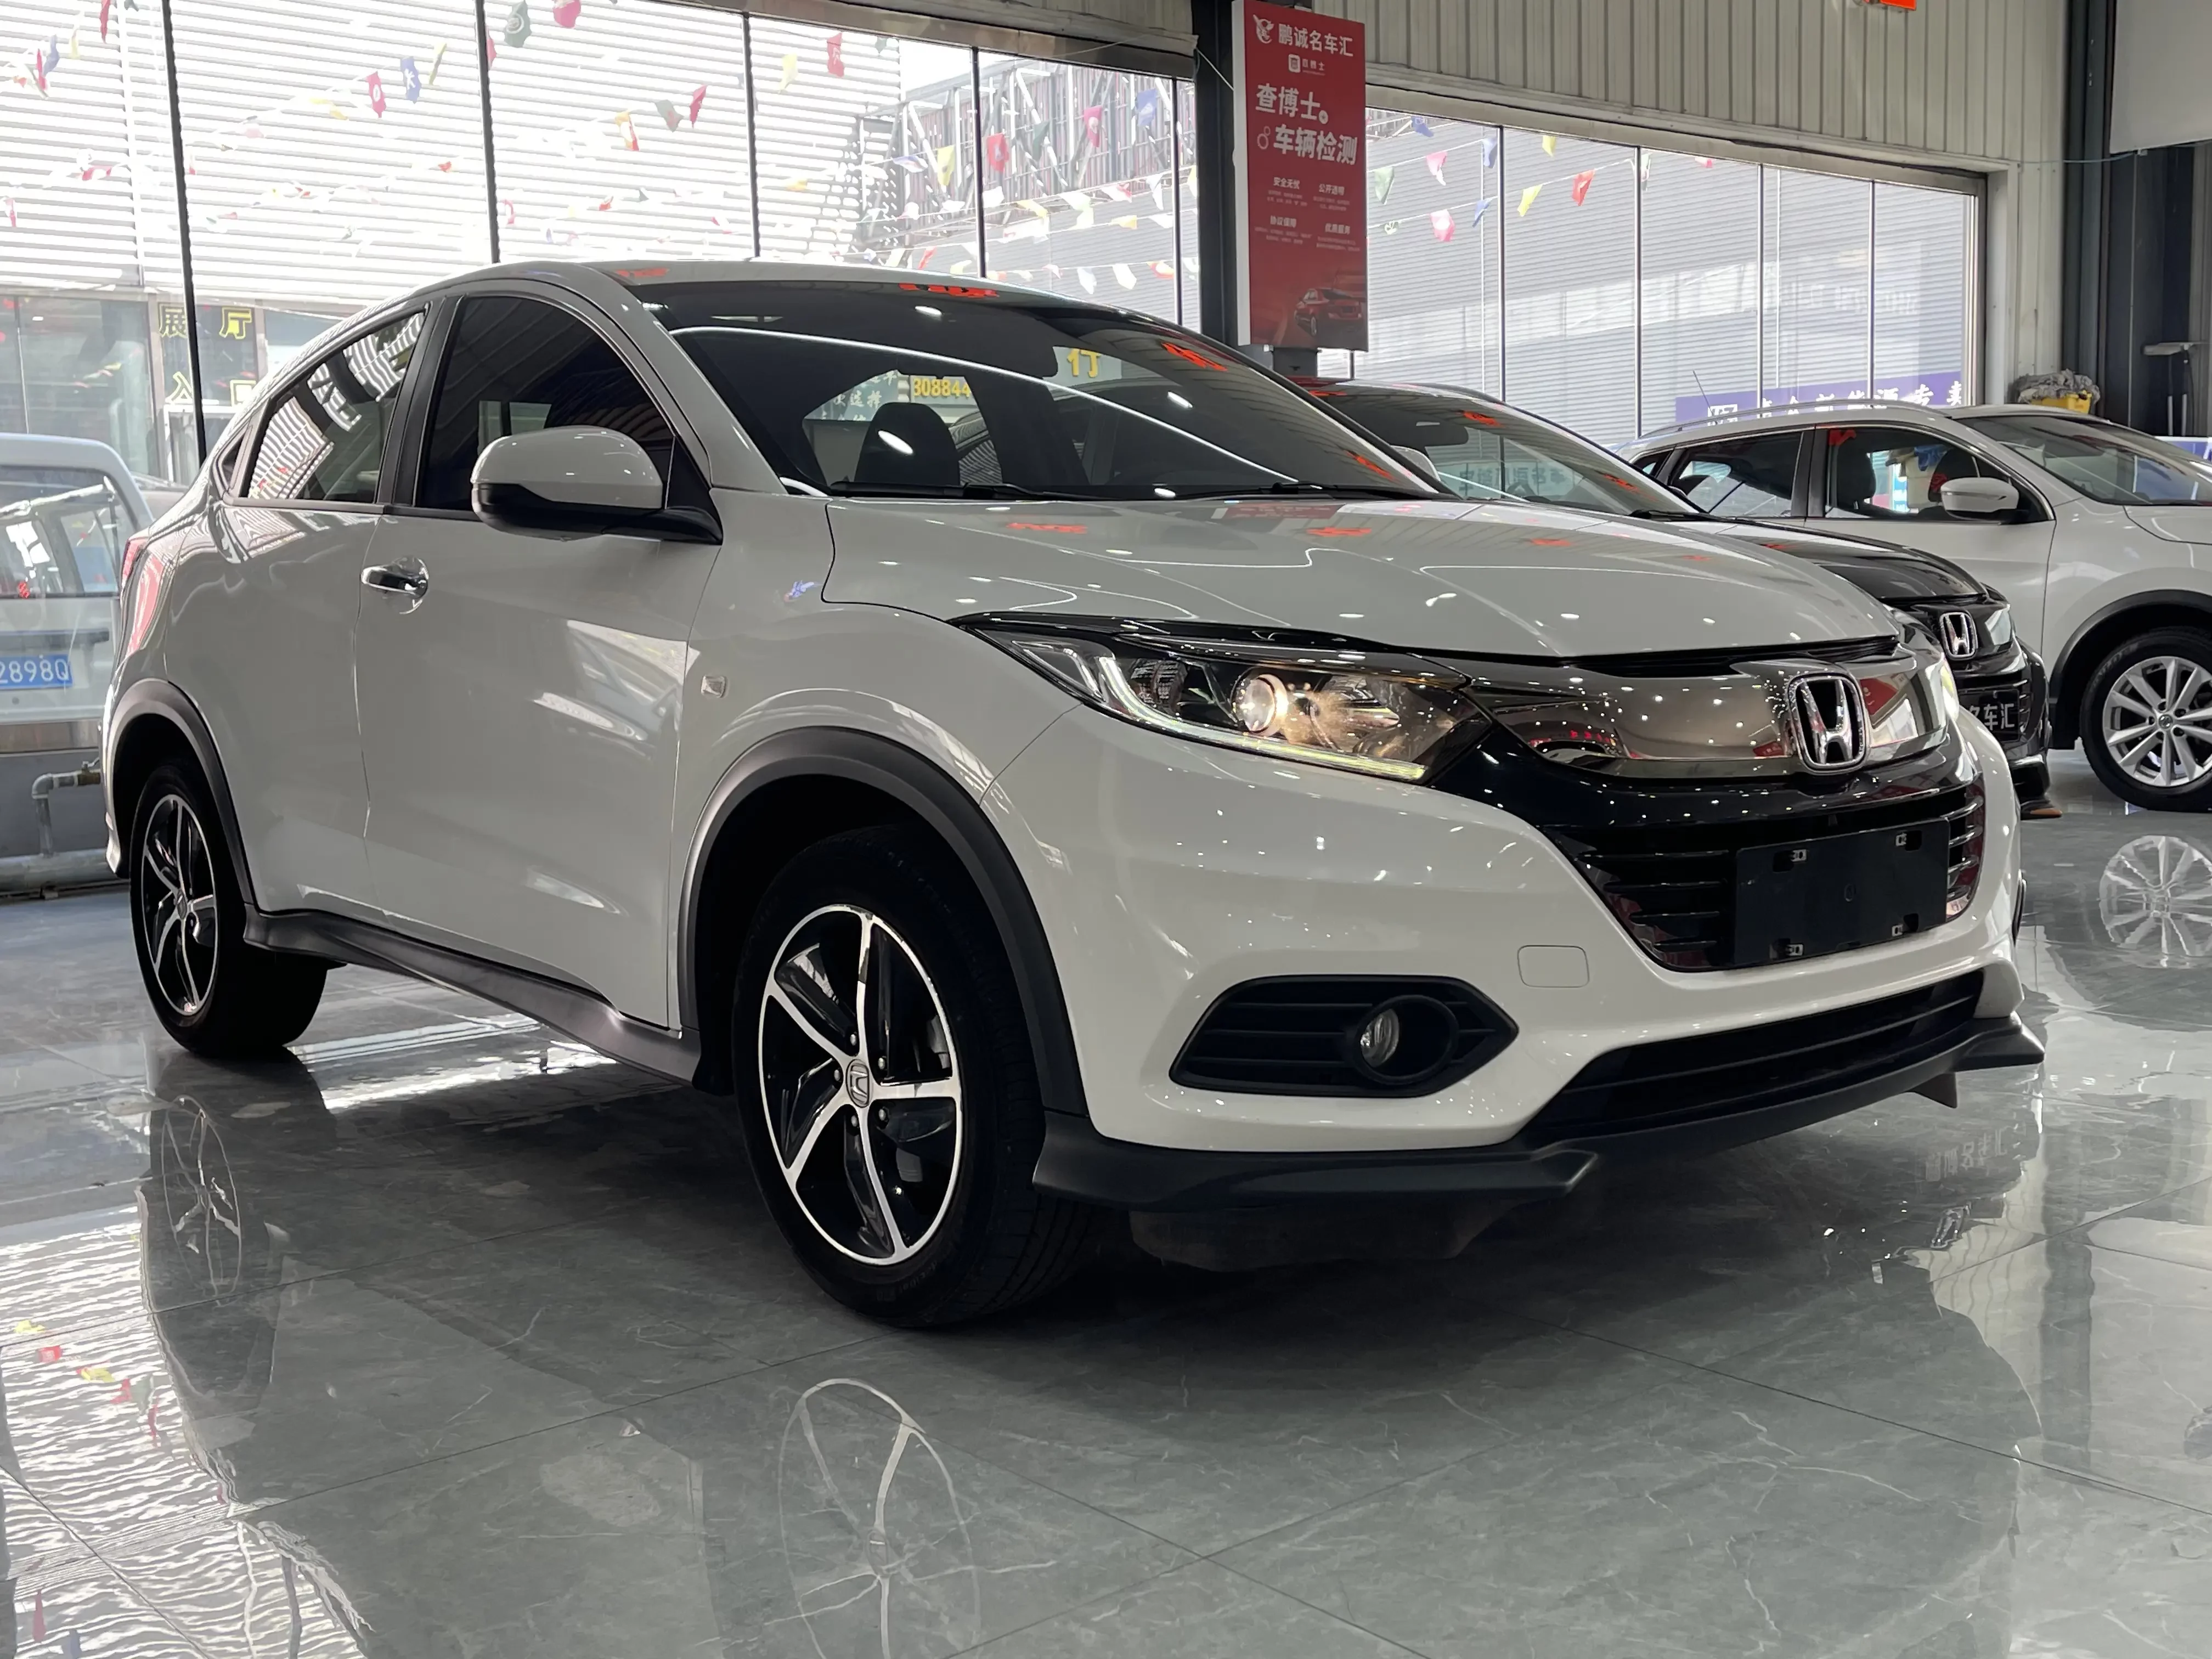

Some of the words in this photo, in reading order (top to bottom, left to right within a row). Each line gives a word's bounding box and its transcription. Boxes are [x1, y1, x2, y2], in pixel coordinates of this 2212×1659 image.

[1278, 24, 1353, 57] 鹏诚名车汇
[1256, 83, 1321, 121] 查博士
[1273, 124, 1357, 165] 车辆检测
[159, 303, 252, 340] 展厅
